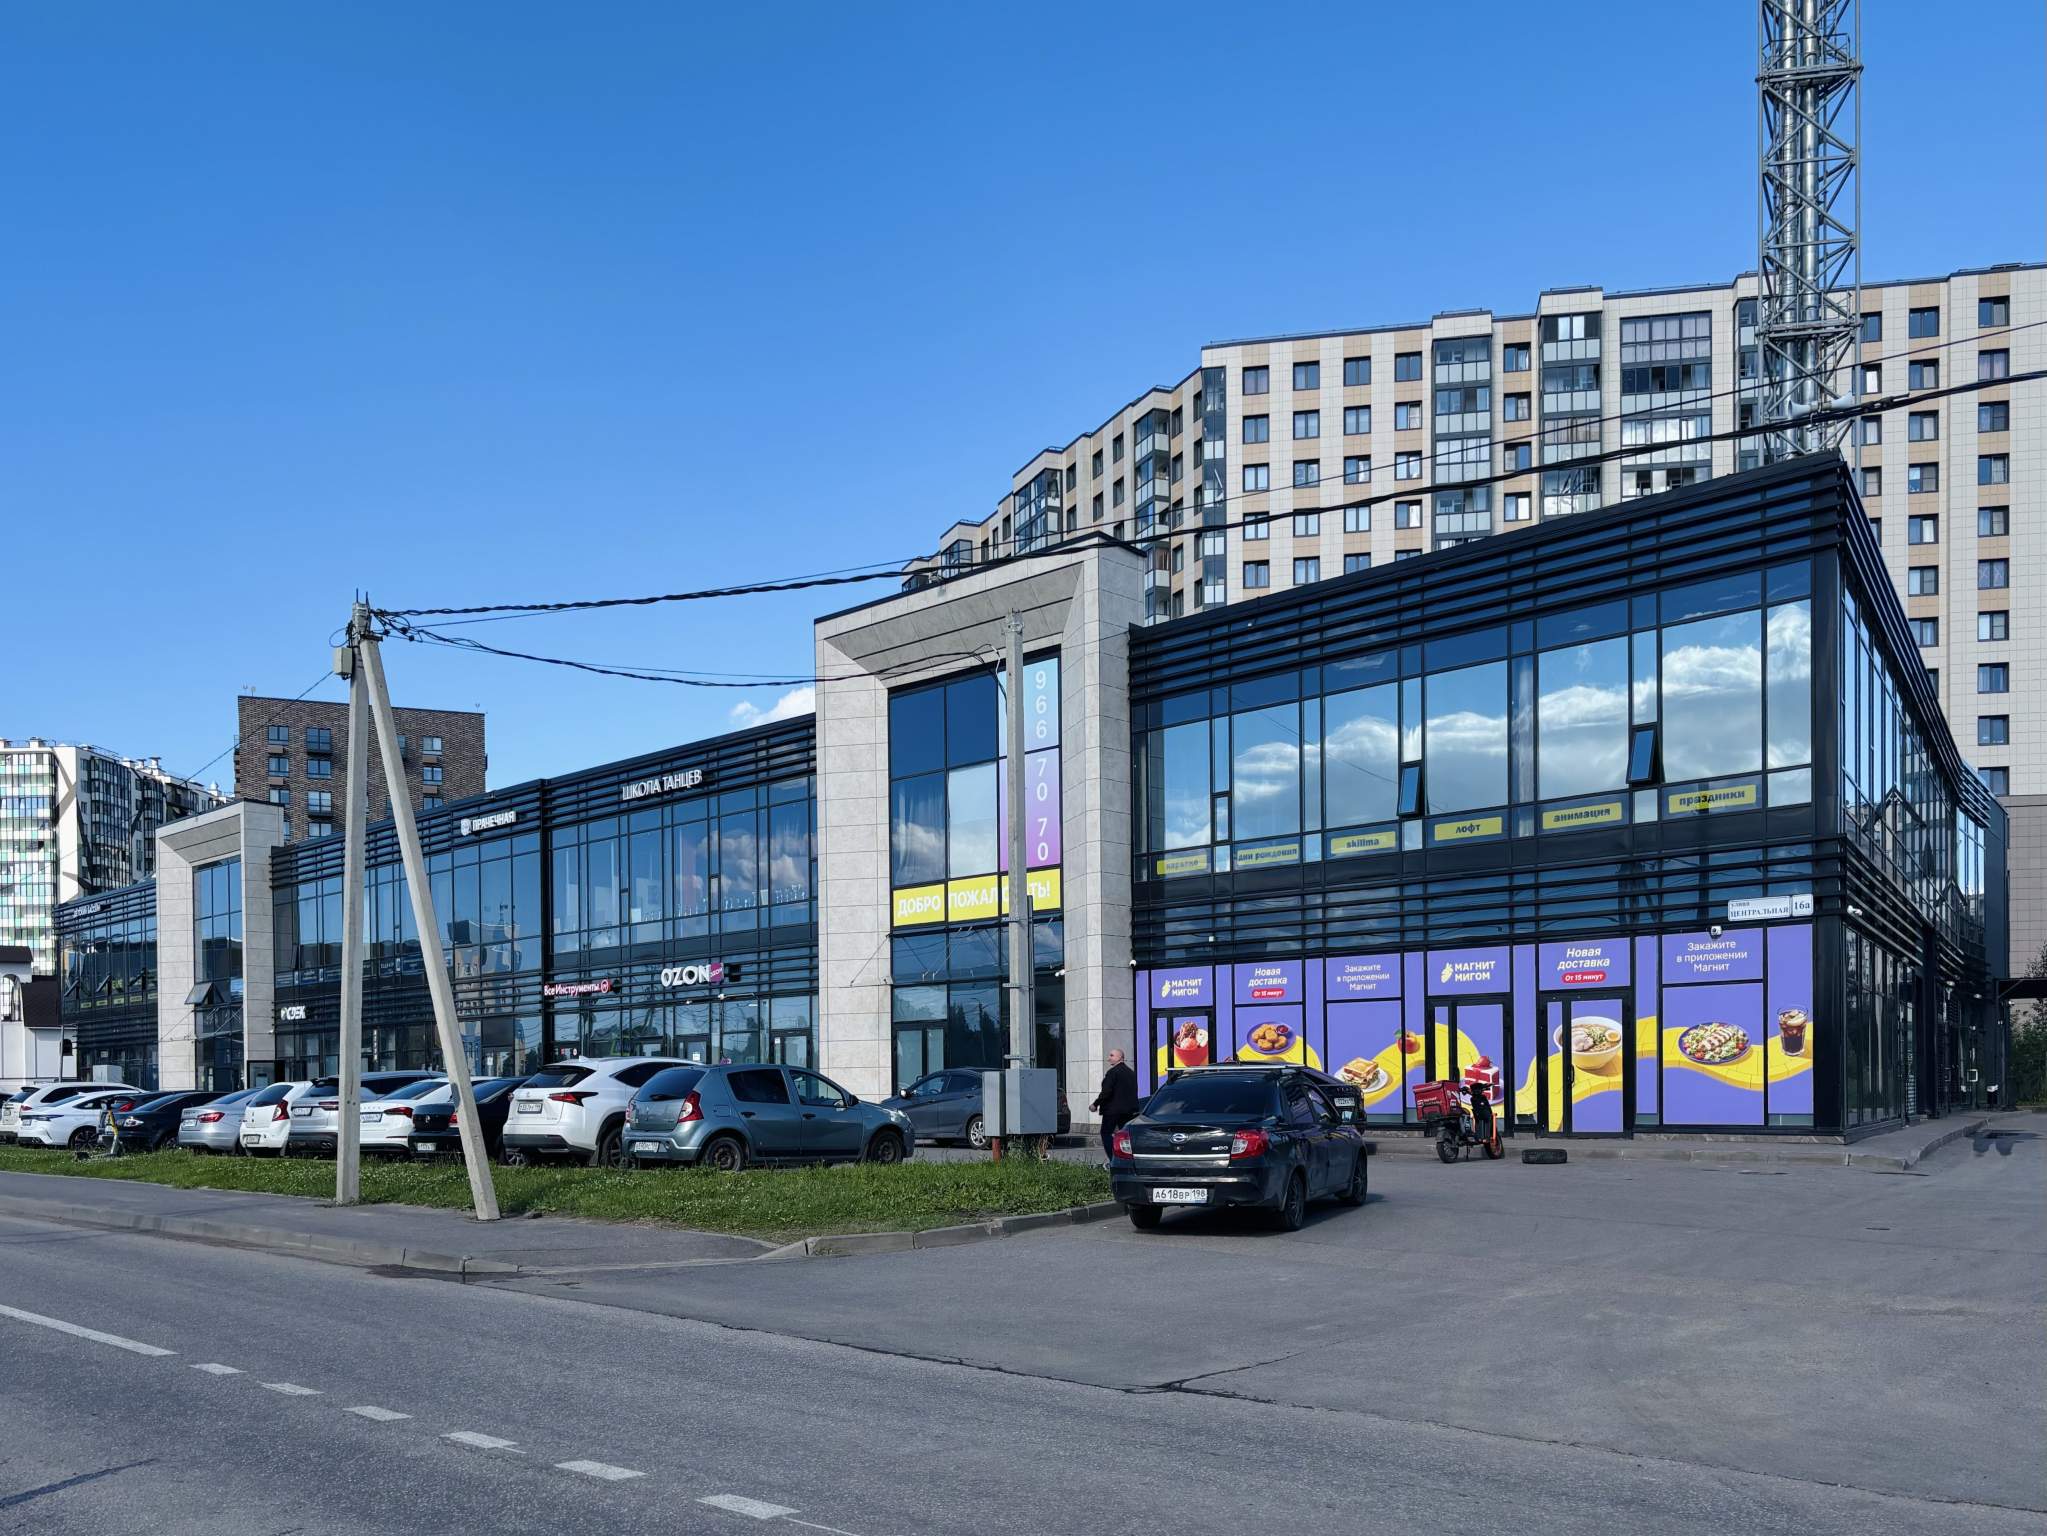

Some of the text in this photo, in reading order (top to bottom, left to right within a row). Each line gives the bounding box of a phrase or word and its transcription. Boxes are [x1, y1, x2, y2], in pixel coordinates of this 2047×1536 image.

[1035, 670, 1048, 861] 966 70 70
[622, 769, 703, 801] ШКОЛА ТАНЦЕВ
[1679, 789, 1745, 807] праздники
[1553, 806, 1611, 823] анимация
[472, 810, 517, 832] ПРАЧЕЧНАЯ
[1455, 822, 1481, 834] лофт
[897, 879, 1050, 917] ДОБРО ПОЖАЛОТЬ!
[1730, 907, 1789, 918] ЦЕНТРАЛЬНАЯ
[1687, 941, 1737, 951] Закажите
[1566, 947, 1602, 958] Новая
[1684, 951, 1748, 963] приложении
[1344, 964, 1381, 973] Закажите
[1454, 961, 1496, 972] МАГНИТ
[1557, 958, 1610, 971] доставка
[1693, 963, 1730, 972] Магнит
[660, 964, 711, 988] OZON
[1254, 967, 1281, 977] Новая
[1342, 972, 1390, 983] приложении
[1454, 972, 1491, 982] МИГОМ
[1564, 974, 1574, 982] От
[1583, 973, 1604, 982] минут
[1171, 978, 1203, 987] МАГНИТ
[1248, 977, 1288, 988] доставка
[1349, 982, 1377, 991] Магнит
[1171, 988, 1199, 997] МИГОМ
